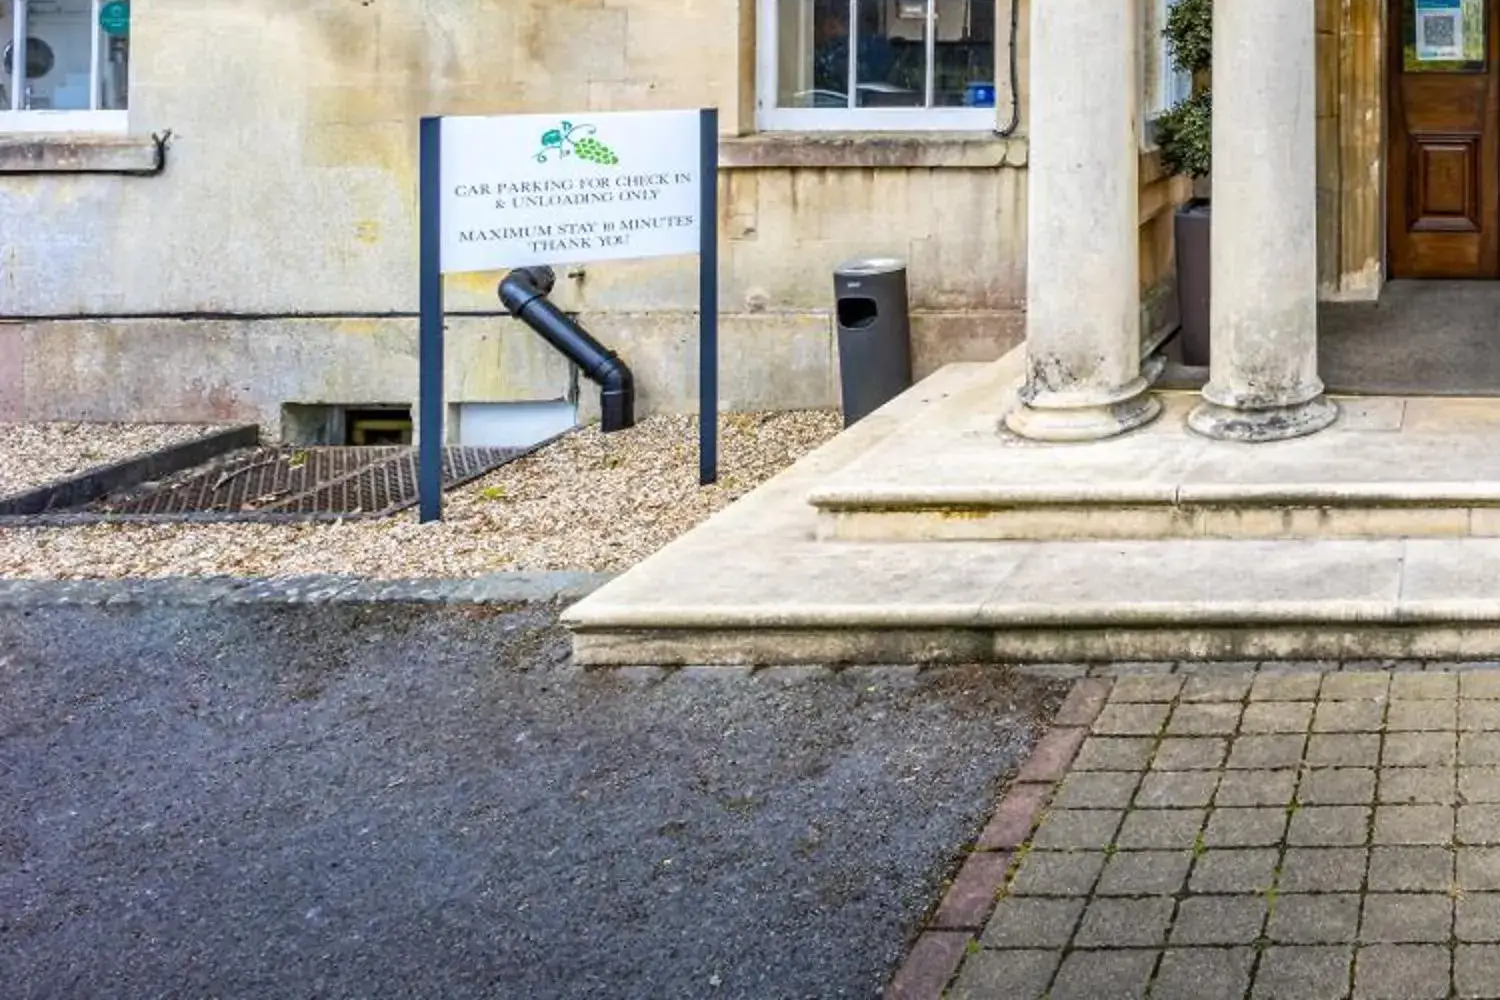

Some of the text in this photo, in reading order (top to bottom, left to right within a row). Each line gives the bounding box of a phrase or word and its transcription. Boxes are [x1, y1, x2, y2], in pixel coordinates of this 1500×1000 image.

[454, 172, 691, 197] CAR PARKING FOR CHECK IN
[495, 188, 660, 209] & UNLOADING ONLY
[459, 225, 551, 242] MAXIMUM
[557, 221, 598, 235] STAY
[620, 214, 693, 231] MINUTES
[528, 233, 629, 252] THANK YOU
